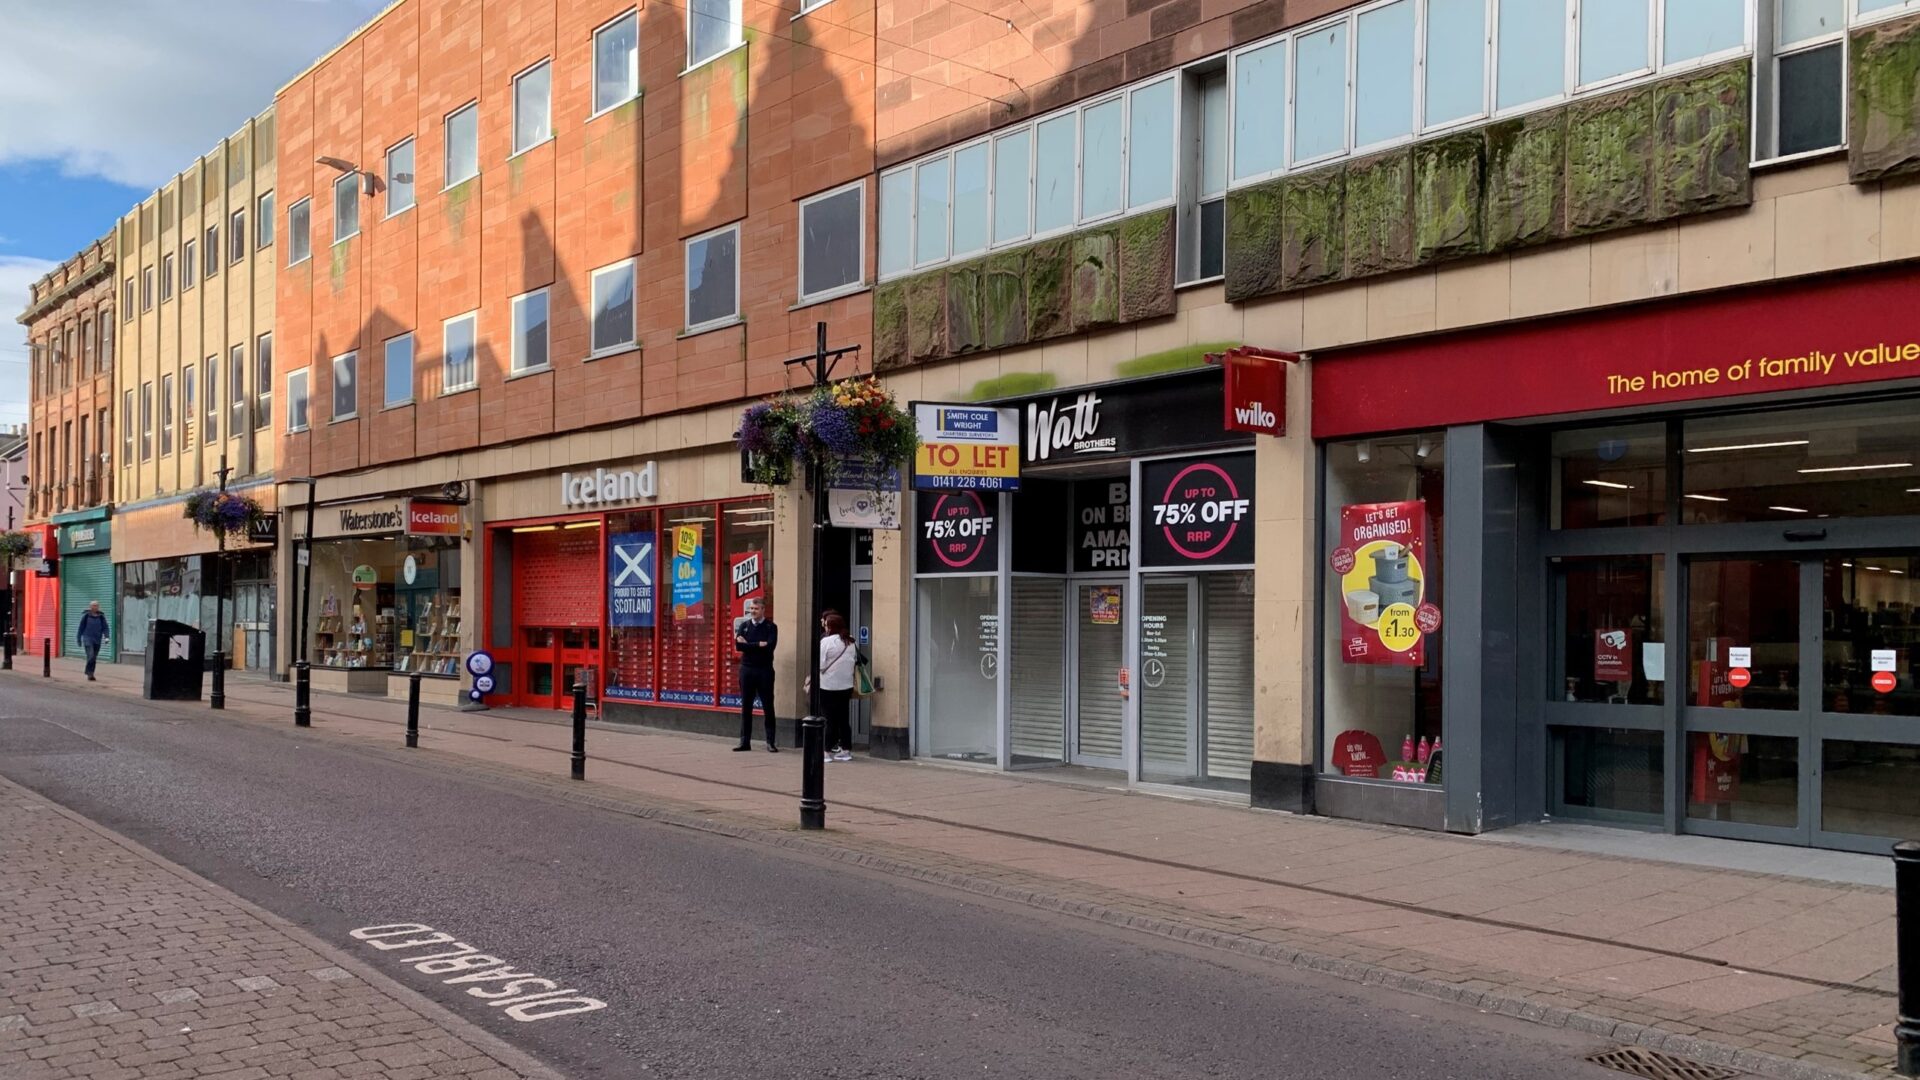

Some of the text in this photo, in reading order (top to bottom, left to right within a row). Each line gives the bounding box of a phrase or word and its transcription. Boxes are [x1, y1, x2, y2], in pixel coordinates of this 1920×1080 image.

[1607, 375, 1645, 394] The
[1652, 368, 1720, 389] home
[1727, 360, 1751, 381] of
[1759, 351, 1836, 377] family
[947, 412, 988, 421] SMITH COLE
[1235, 401, 1276, 428] wilko
[1028, 391, 1102, 461] Watt
[1073, 437, 1116, 450] BROTHERS
[925, 444, 1009, 468] TO LET
[562, 461, 657, 506] Iceland
[933, 476, 1002, 488] 0141 226 4061
[1185, 487, 1215, 498] UP TO
[339, 504, 402, 531] Waterstone's
[412, 510, 458, 524] Iceland
[947, 507, 969, 516] UP TO
[1081, 507, 1106, 525] ON
[1153, 499, 1249, 525] 75% OFF
[1365, 507, 1398, 523] LET'S GET
[255, 520, 273, 533] W
[925, 517, 993, 539] 75% OFF
[1354, 518, 1412, 541] ORGANISED!
[681, 530, 695, 546] 10%
[1187, 531, 1211, 542] RRP
[949, 543, 967, 552] RRP
[735, 556, 756, 580] 7 DAY
[614, 587, 651, 598] PROUD TO SERVE
[738, 574, 758, 597] DEAL
[614, 599, 651, 613] SCOTLAND
[1385, 619, 1414, 637] £1.30
[349, 923, 607, 1022] DISABLED
